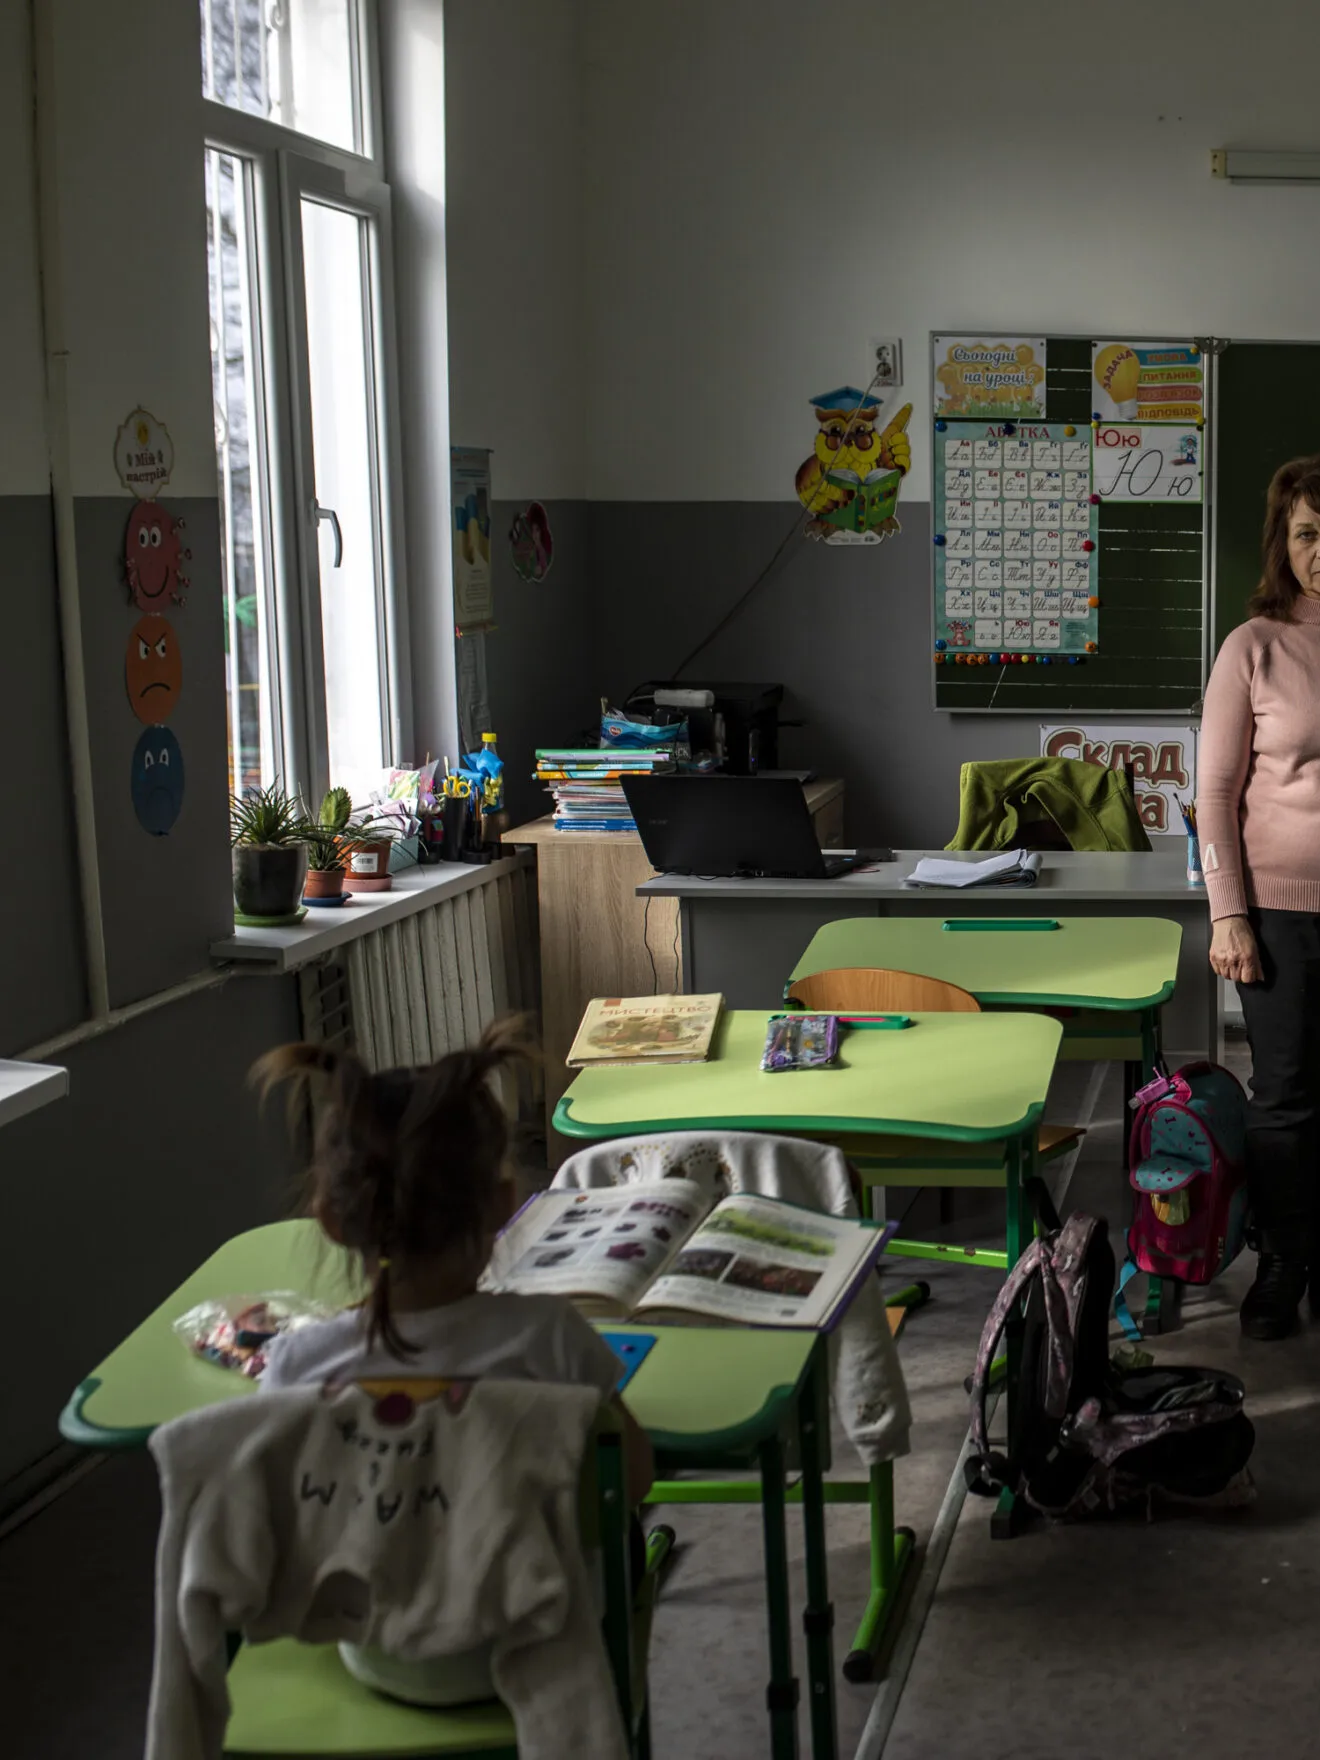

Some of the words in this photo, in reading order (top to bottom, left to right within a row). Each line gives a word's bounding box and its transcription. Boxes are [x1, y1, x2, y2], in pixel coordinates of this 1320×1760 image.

[954, 348, 1016, 367] Сьогодні
[1146, 352, 1187, 362] УМОВА
[1103, 350, 1134, 389] ЗАДАЧА
[964, 372, 981, 382] на
[1143, 370, 1197, 382] ПИТАННЯ
[1137, 407, 1200, 419] ВІДПОВІДЬ
[1096, 428, 1140, 447] Юю
[600, 1006, 711, 1017] МИСТЕЦТВО
